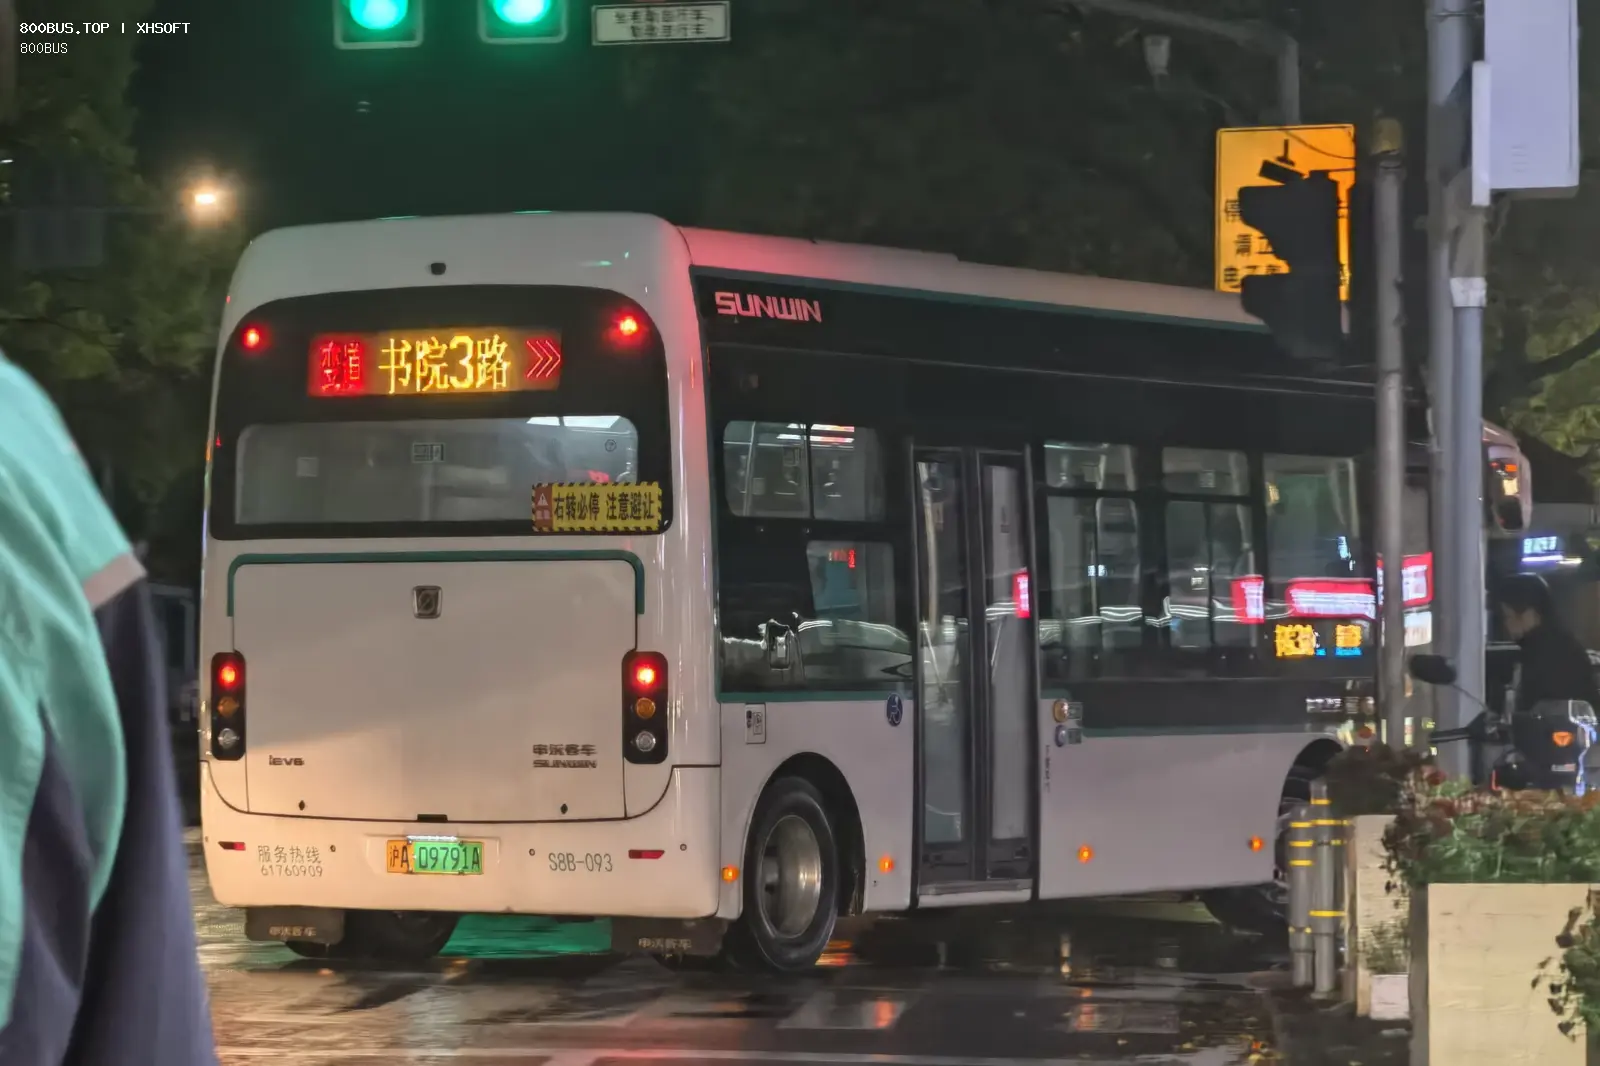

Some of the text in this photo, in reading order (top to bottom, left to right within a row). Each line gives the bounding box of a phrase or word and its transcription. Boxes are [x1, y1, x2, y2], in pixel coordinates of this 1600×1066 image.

[714, 291, 822, 323] SUNWIN
[378, 333, 512, 395] 书院3路
[553, 491, 655, 521] 右转必停 注意避让
[257, 845, 322, 864] 服务热线
[548, 851, 614, 873] S8B-093
[260, 864, 324, 878] 61760909
